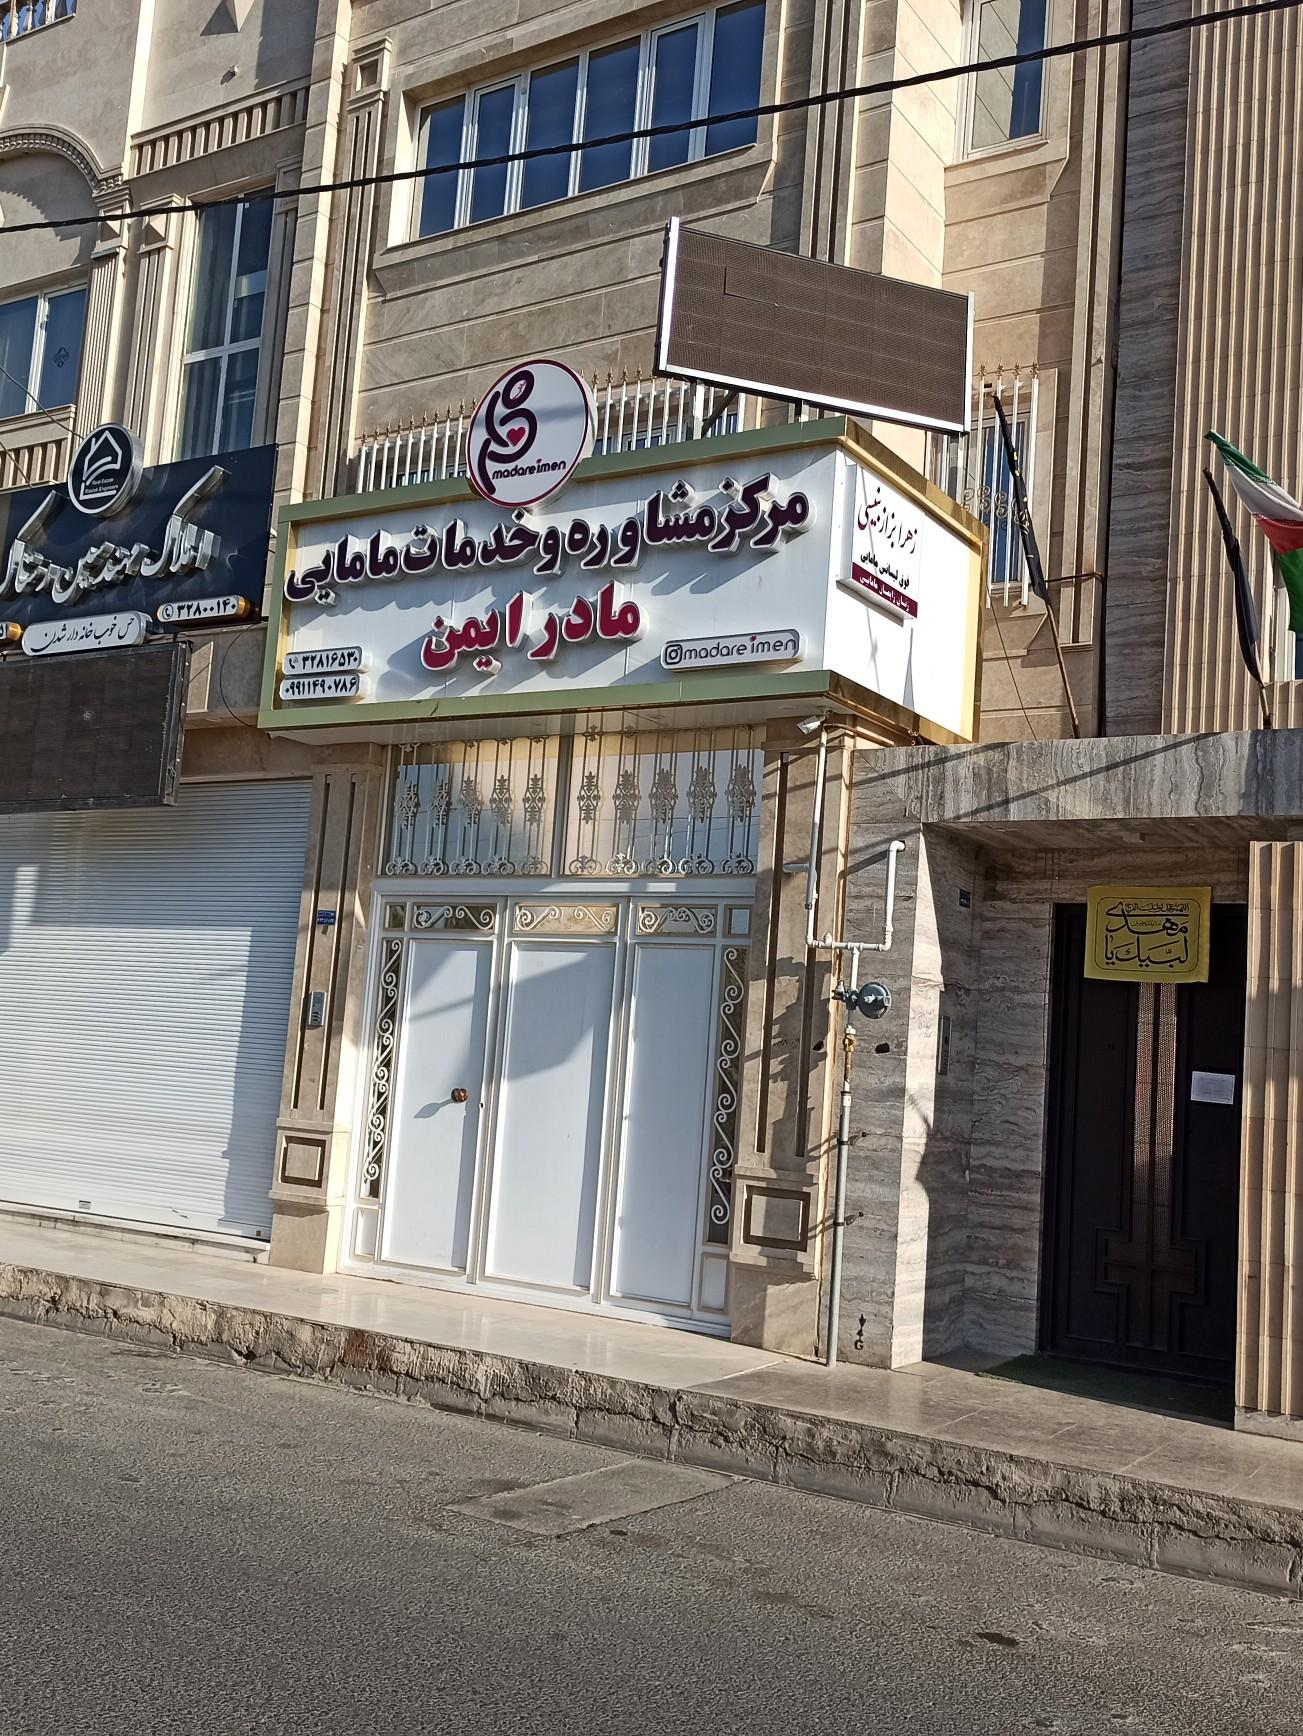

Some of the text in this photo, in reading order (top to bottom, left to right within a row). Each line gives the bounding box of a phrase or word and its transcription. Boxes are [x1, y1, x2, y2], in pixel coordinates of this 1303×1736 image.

[492, 459, 566, 480] madareimen
[284, 473, 811, 605] مرکز مشاوره و خدمات مامایی
[878, 506, 897, 549] بزاز
[897, 521, 918, 555] زهرا
[860, 551, 910, 590] فوق لیسانس مامایی
[176, 598, 236, 618] ۳۲۸۰۰۱۴۰
[30, 623, 66, 653] شدن
[66, 627, 79, 641] دار
[79, 622, 93, 641] خانه
[93, 615, 117, 645] خوب
[118, 617, 135, 640] حس
[421, 580, 641, 672] مادر ایمن
[301, 650, 358, 670] ۳۲۸۱۶۵۳۰
[285, 677, 357, 696] ۰۹۹۱۱۴۹۰۷۸۶
